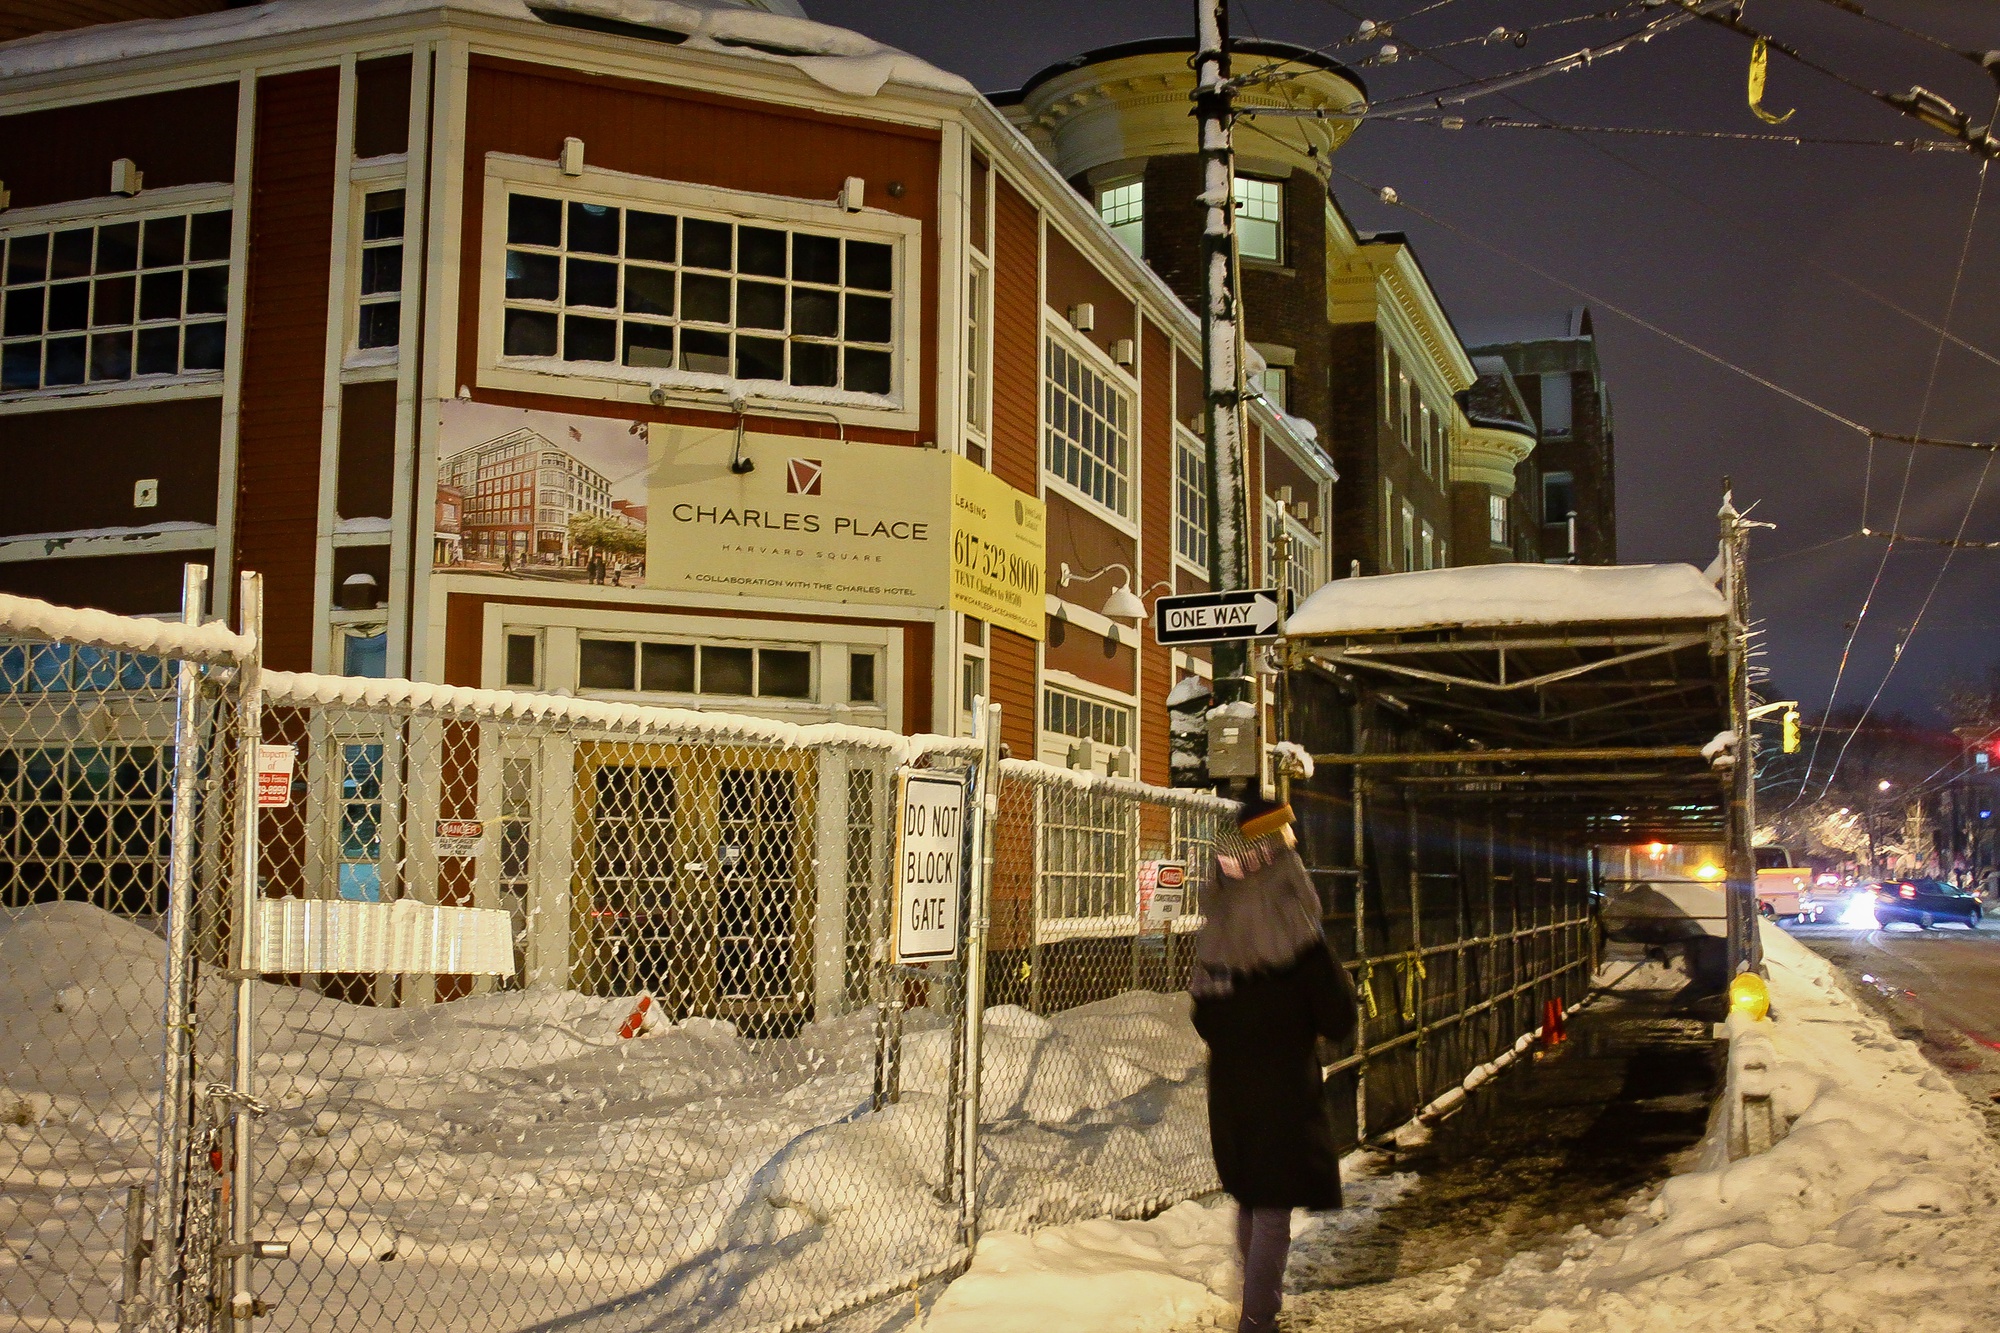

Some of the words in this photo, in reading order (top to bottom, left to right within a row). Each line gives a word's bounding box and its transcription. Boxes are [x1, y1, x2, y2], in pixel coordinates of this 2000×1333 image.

[955, 494, 987, 519] LEASING
[673, 503, 820, 533] CHARLES
[834, 517, 928, 541] PLACE
[722, 544, 804, 557] HARVARD
[816, 551, 882, 562] SQUARE
[954, 528, 979, 570] 617
[982, 541, 1006, 583] 523
[1009, 553, 1039, 596] 8000
[695, 574, 783, 587] COLLABORATION
[785, 580, 811, 589] WITH
[813, 582, 832, 591] THE
[836, 584, 881, 594] CHARLES
[883, 587, 916, 596] HOTEL
[1171, 608, 1207, 628] ONE
[1213, 605, 1252, 625] WAY
[441, 823, 477, 834] DANGER
[907, 804, 926, 837] DO
[932, 806, 958, 838] NOT
[907, 852, 953, 884] BLOCK
[911, 898, 946, 931] GATE
